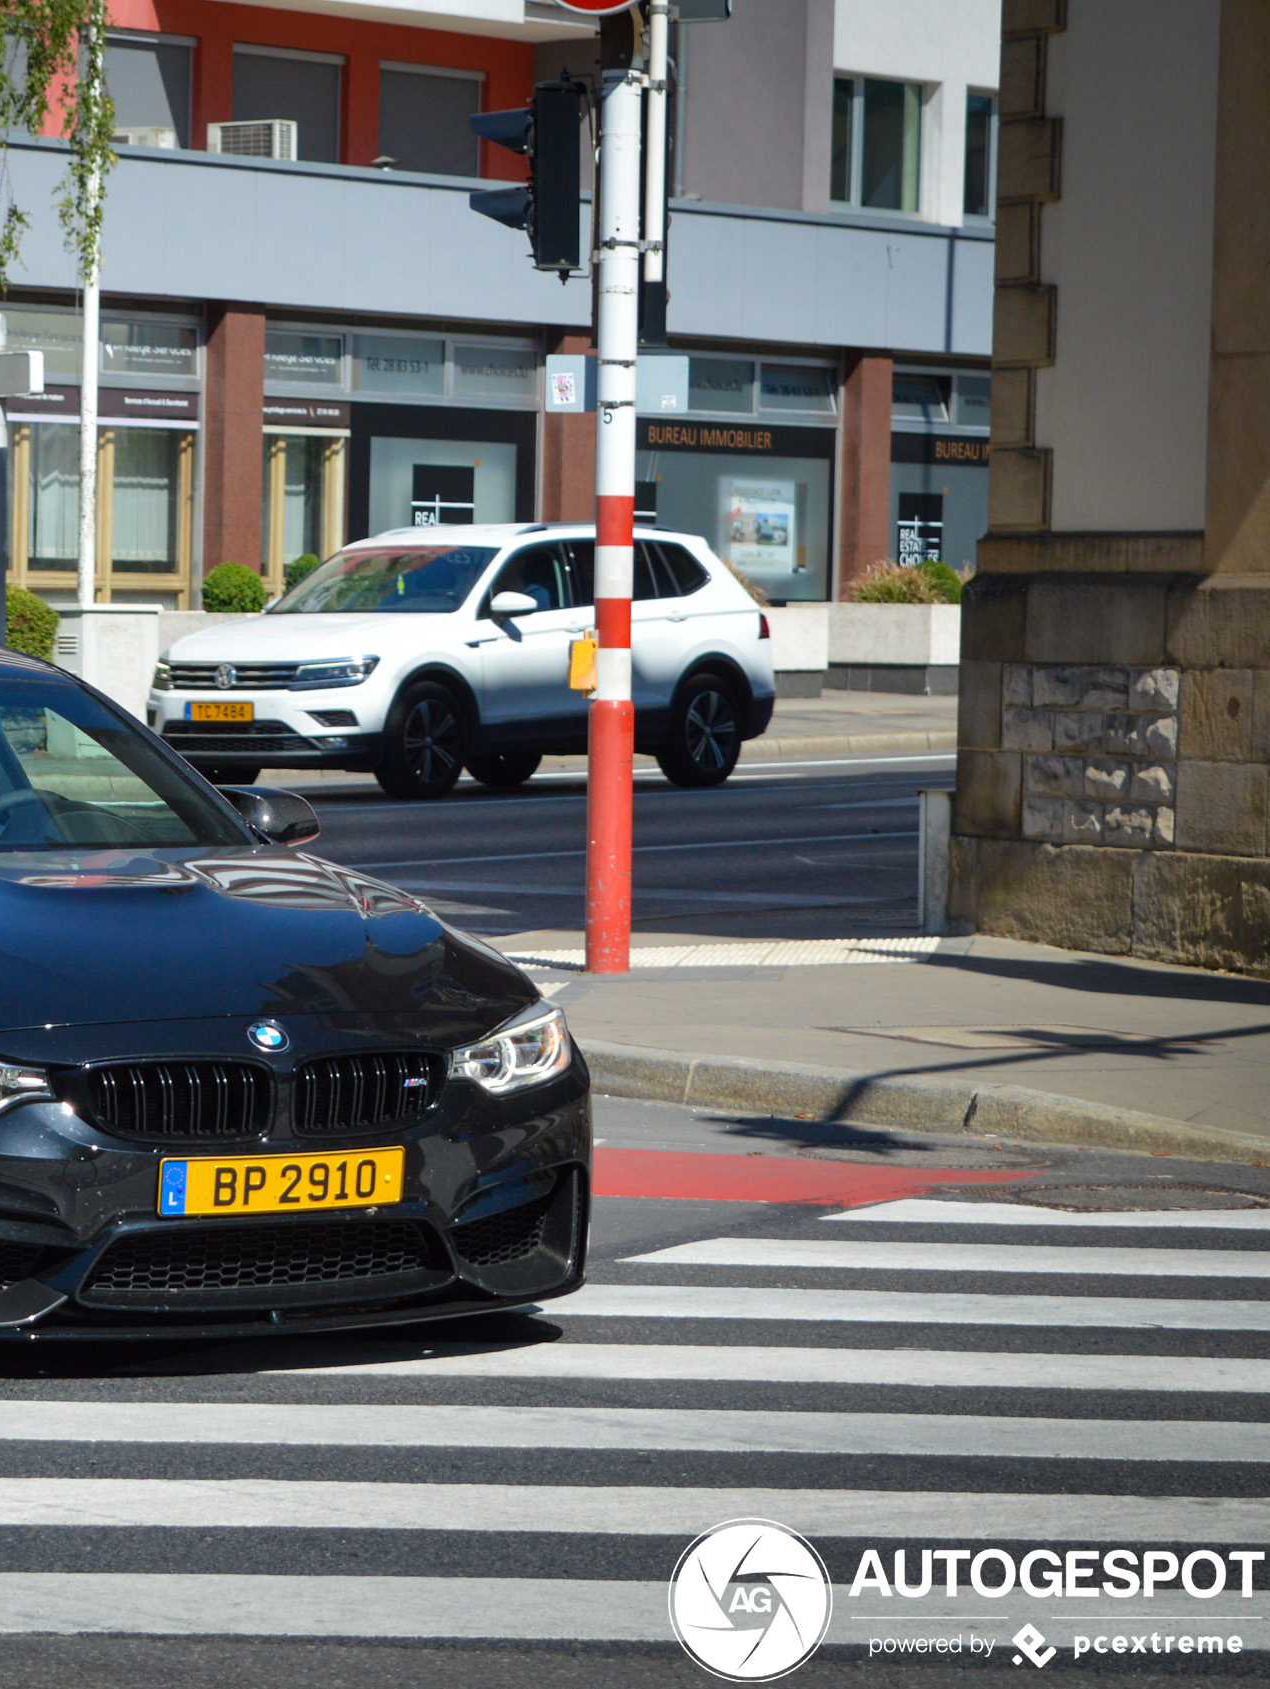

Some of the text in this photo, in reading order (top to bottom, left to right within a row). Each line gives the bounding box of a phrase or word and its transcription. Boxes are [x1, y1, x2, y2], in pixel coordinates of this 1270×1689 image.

[383, 358, 394, 372] 28
[396, 359, 407, 373] 83
[603, 407, 613, 424] 5
[648, 425, 772, 449] BUREAU IMMOBILIER
[935, 441, 980, 459] BUREAU
[197, 704, 211, 719] TC
[214, 704, 245, 719] 7484
[168, 1158, 377, 1207] L BP 2910
